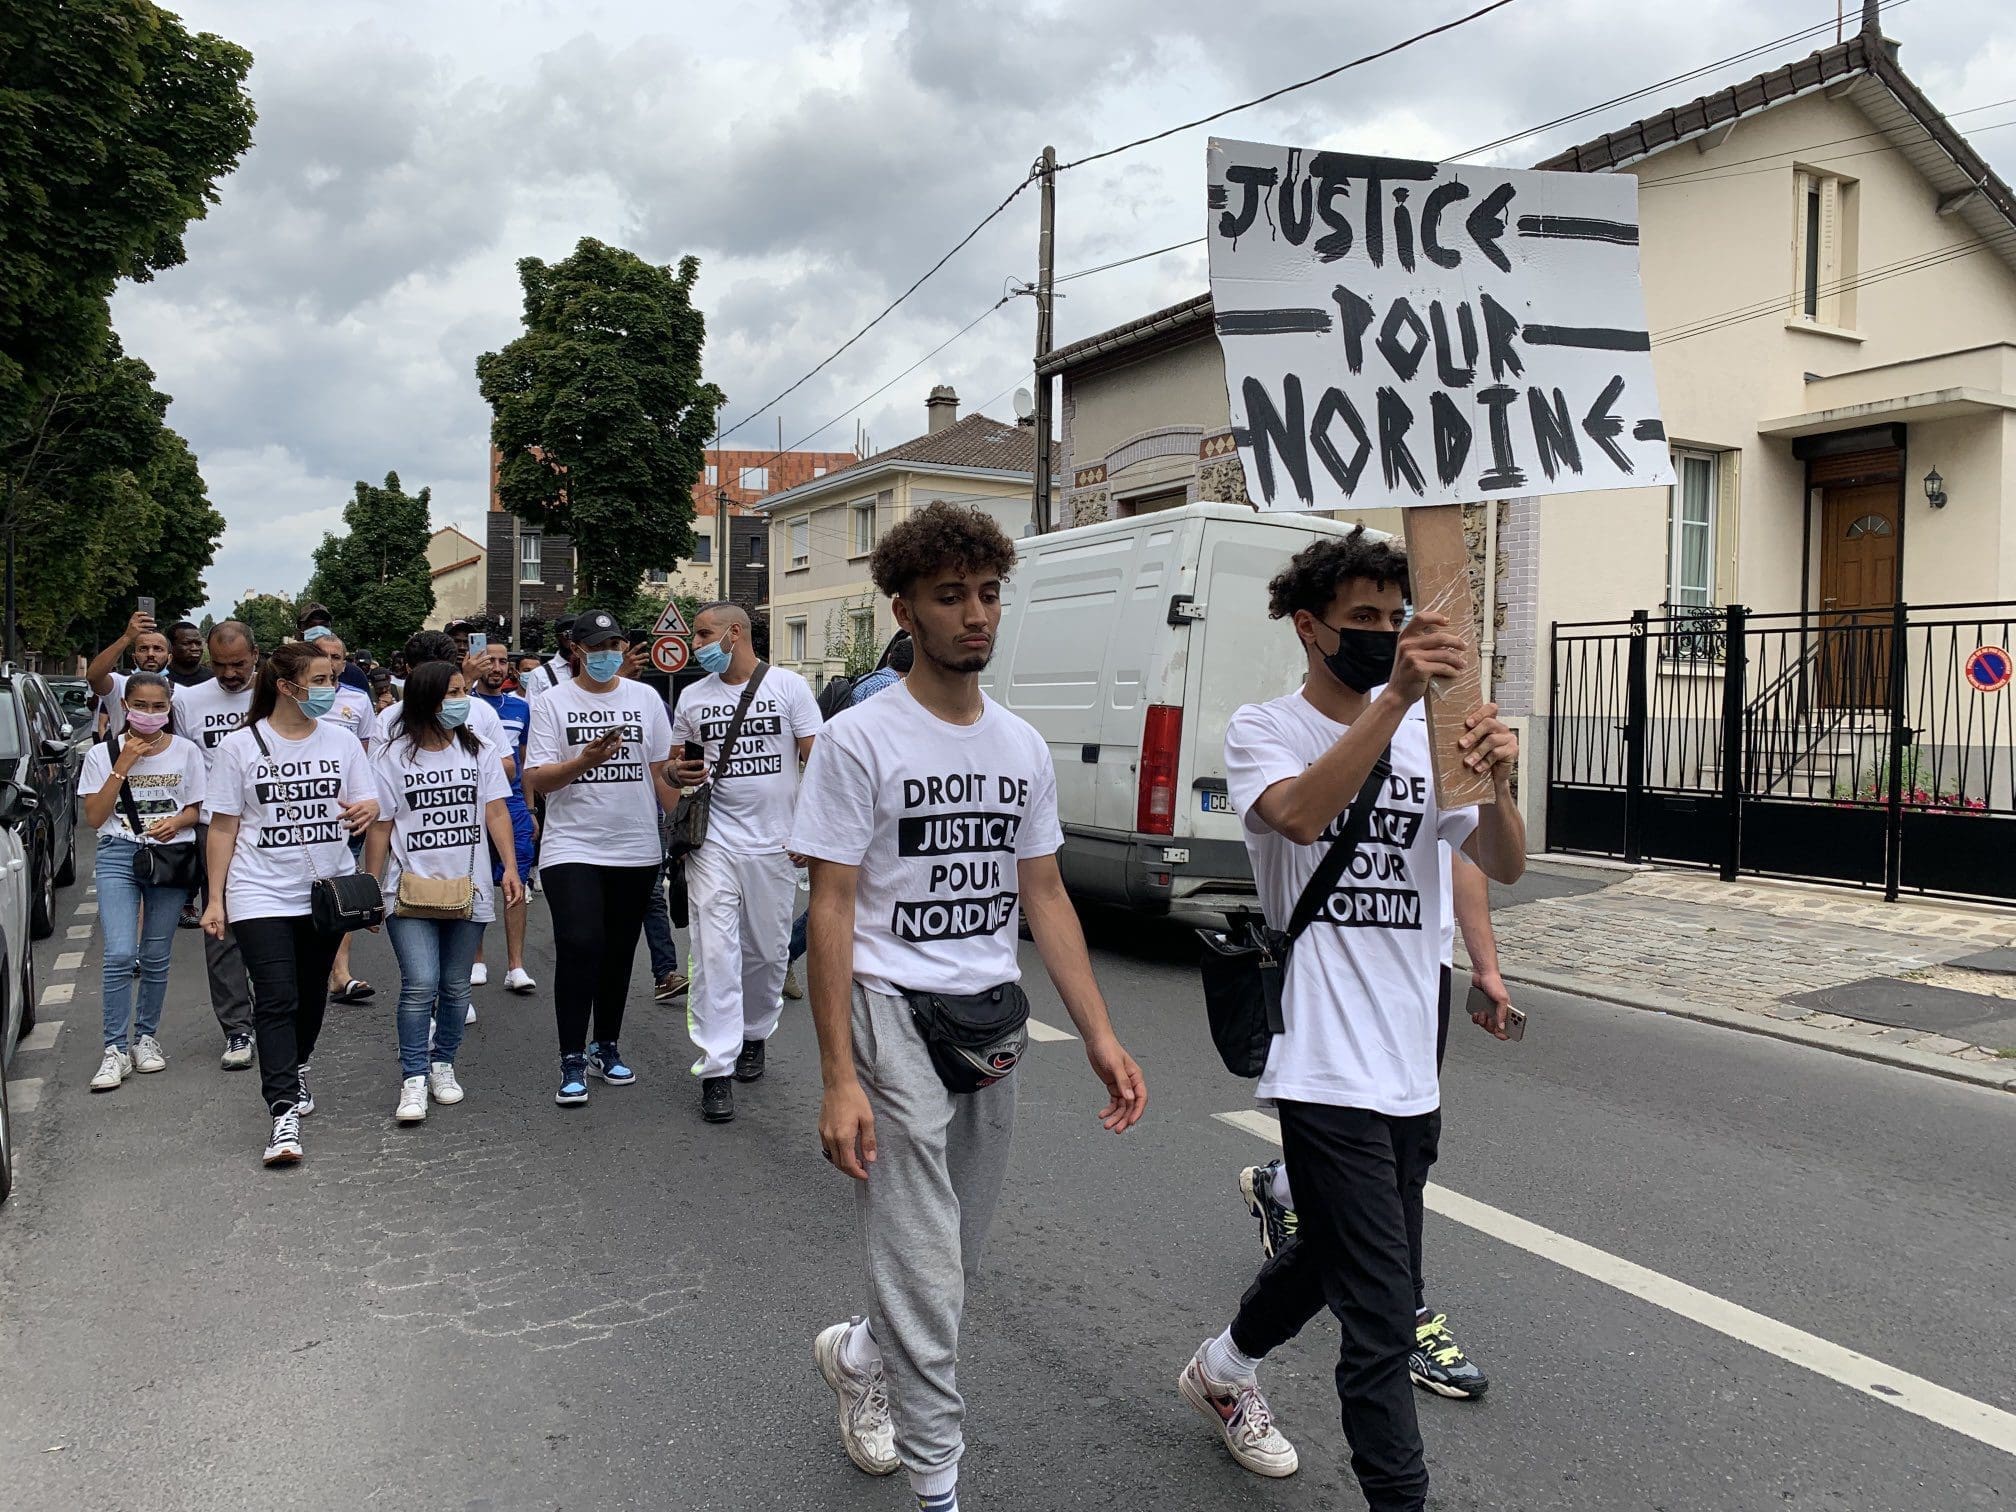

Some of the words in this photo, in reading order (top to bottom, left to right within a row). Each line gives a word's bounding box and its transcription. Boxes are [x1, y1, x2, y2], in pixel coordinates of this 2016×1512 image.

[1332, 284, 1525, 387] POUR
[1242, 373, 1634, 507] NORDINE
[1631, 623, 1643, 637] 43
[567, 711, 615, 723] DROIT
[622, 711, 641, 722] DE
[702, 705, 736, 720] DRO
[756, 700, 776, 713] DE
[707, 720, 774, 739] JUTICE
[257, 761, 311, 779] DROIT
[319, 760, 340, 774] DE
[404, 769, 453, 788] DROIT
[460, 768, 477, 781] DE
[578, 766, 642, 781] ORDINE
[266, 780, 336, 801] JUSTICE
[415, 787, 473, 808] JUSTICE
[903, 774, 986, 809] DROIT
[998, 775, 1028, 807] DE
[1390, 774, 1426, 804] DE
[276, 804, 328, 822] POUR
[422, 809, 469, 827] POUR
[408, 827, 479, 849] NORDINE
[929, 861, 1000, 892] POUR
[1350, 851, 1406, 881] OUR
[1317, 891, 1422, 925] ORDIN
